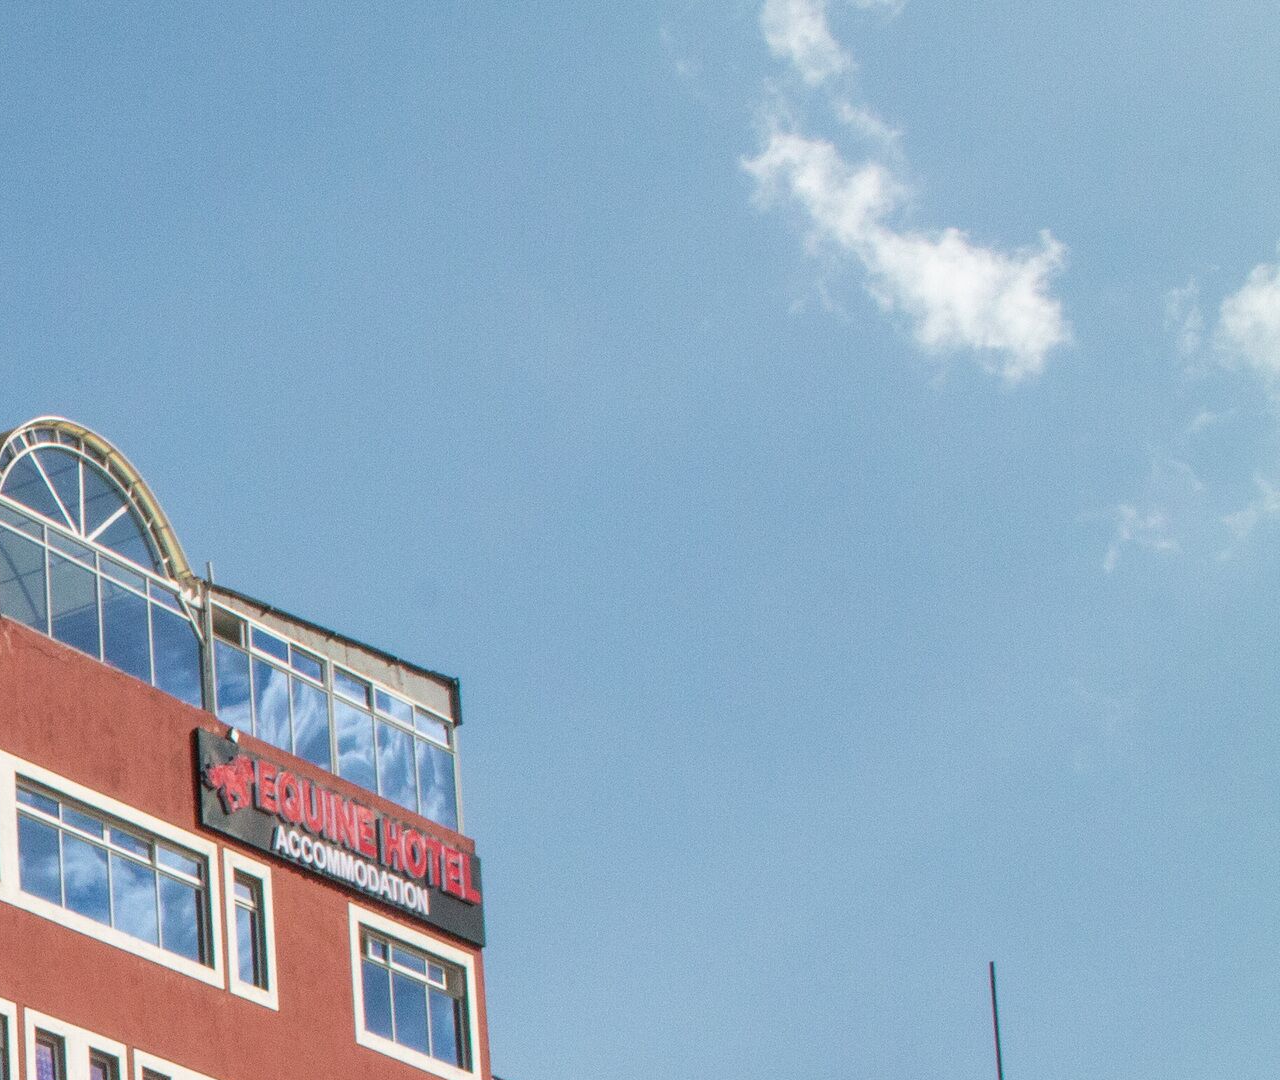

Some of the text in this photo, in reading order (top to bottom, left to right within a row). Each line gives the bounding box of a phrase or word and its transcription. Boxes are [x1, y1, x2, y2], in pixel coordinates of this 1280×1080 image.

[253, 759, 481, 905] EQUINE HOTEL
[274, 825, 430, 915] ACCOMMODATION
